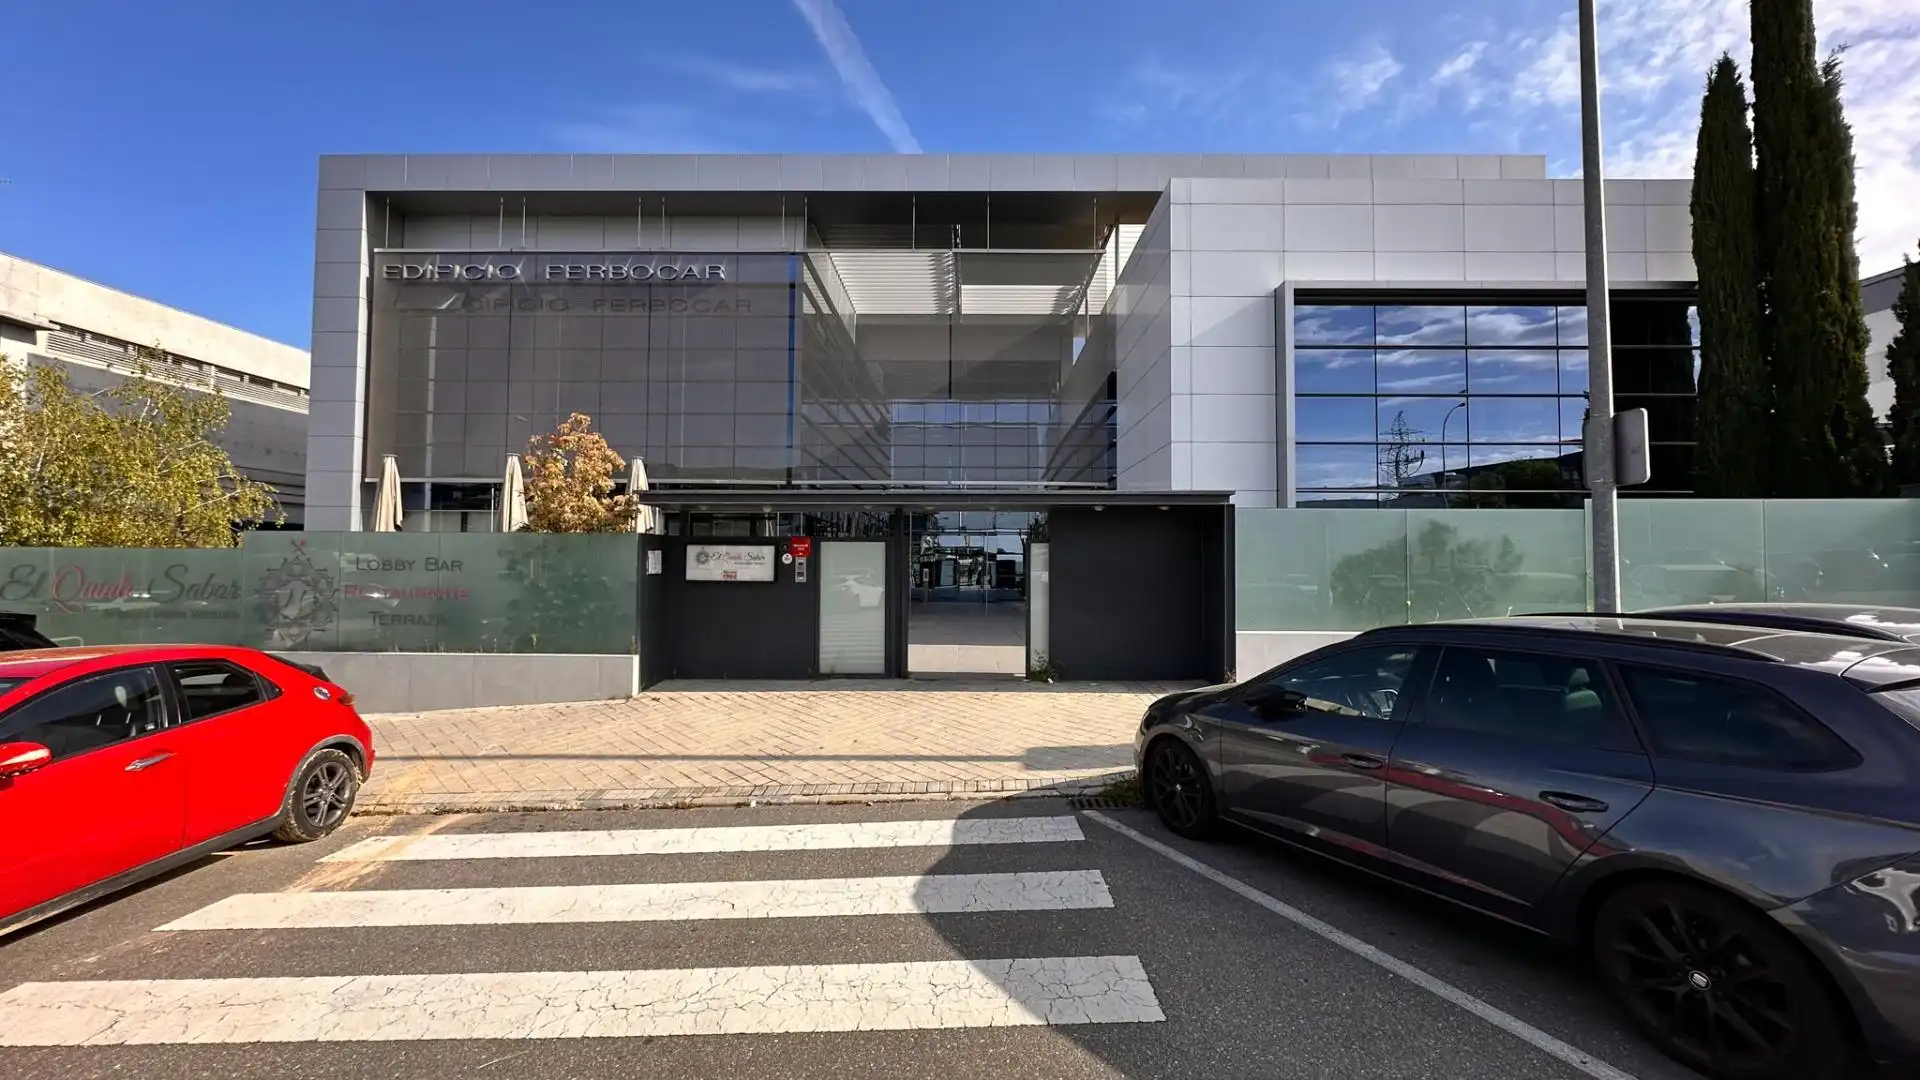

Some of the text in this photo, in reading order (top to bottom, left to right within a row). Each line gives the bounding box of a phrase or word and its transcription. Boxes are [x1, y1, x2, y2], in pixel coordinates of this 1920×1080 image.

[382, 264, 727, 281] EDIFICIO FERBOCAR
[355, 557, 464, 572] LOBBY BAR
[1, 564, 49, 600] El
[149, 564, 242, 603] Sabor
